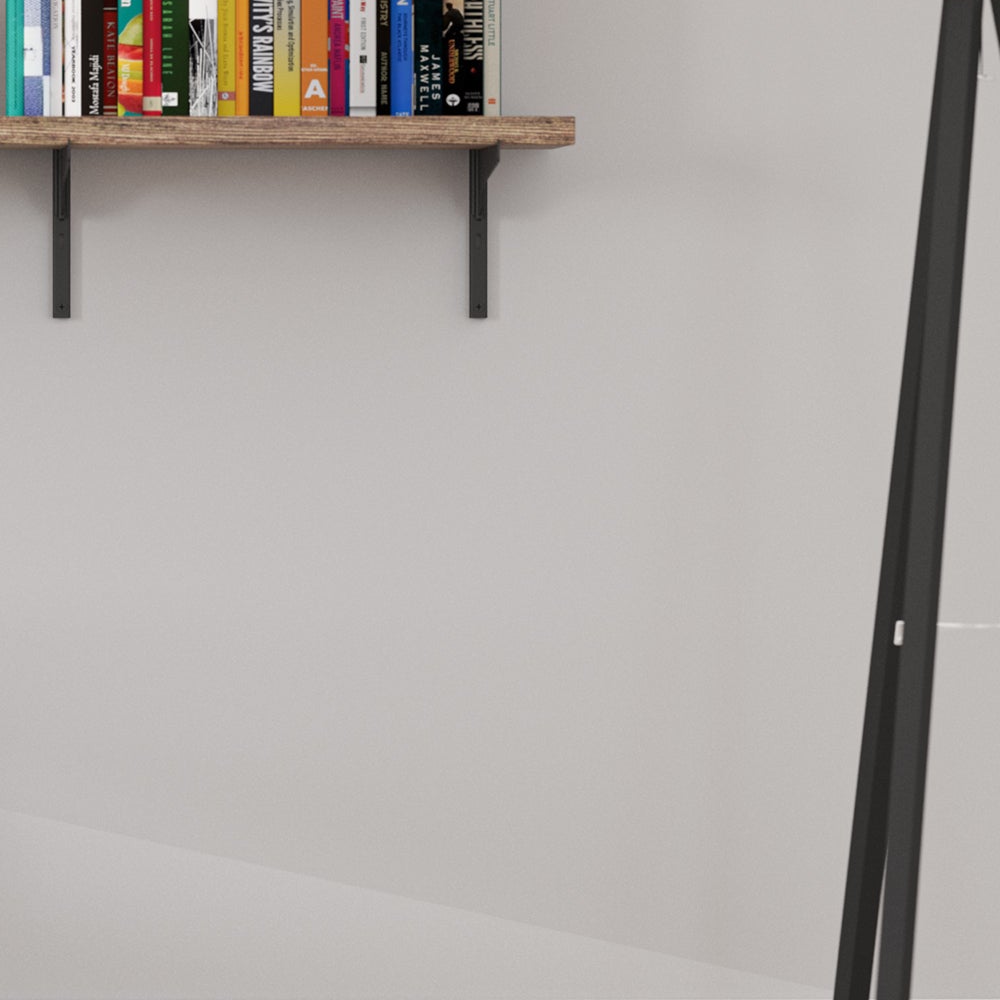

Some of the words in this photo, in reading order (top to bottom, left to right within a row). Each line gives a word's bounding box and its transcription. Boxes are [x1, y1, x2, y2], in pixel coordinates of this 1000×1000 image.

[106, 21, 116, 51] KATE
[487, 23, 496, 47] LITTLE
[106, 54, 116, 98] BEATON
[252, 34, 273, 93] RAINBOW
[380, 51, 389, 82] AUTHOR
[420, 44, 430, 111] MAXWELL
[431, 54, 441, 101] JAMES
[303, 79, 327, 99] A
[380, 83, 389, 105] NAME
